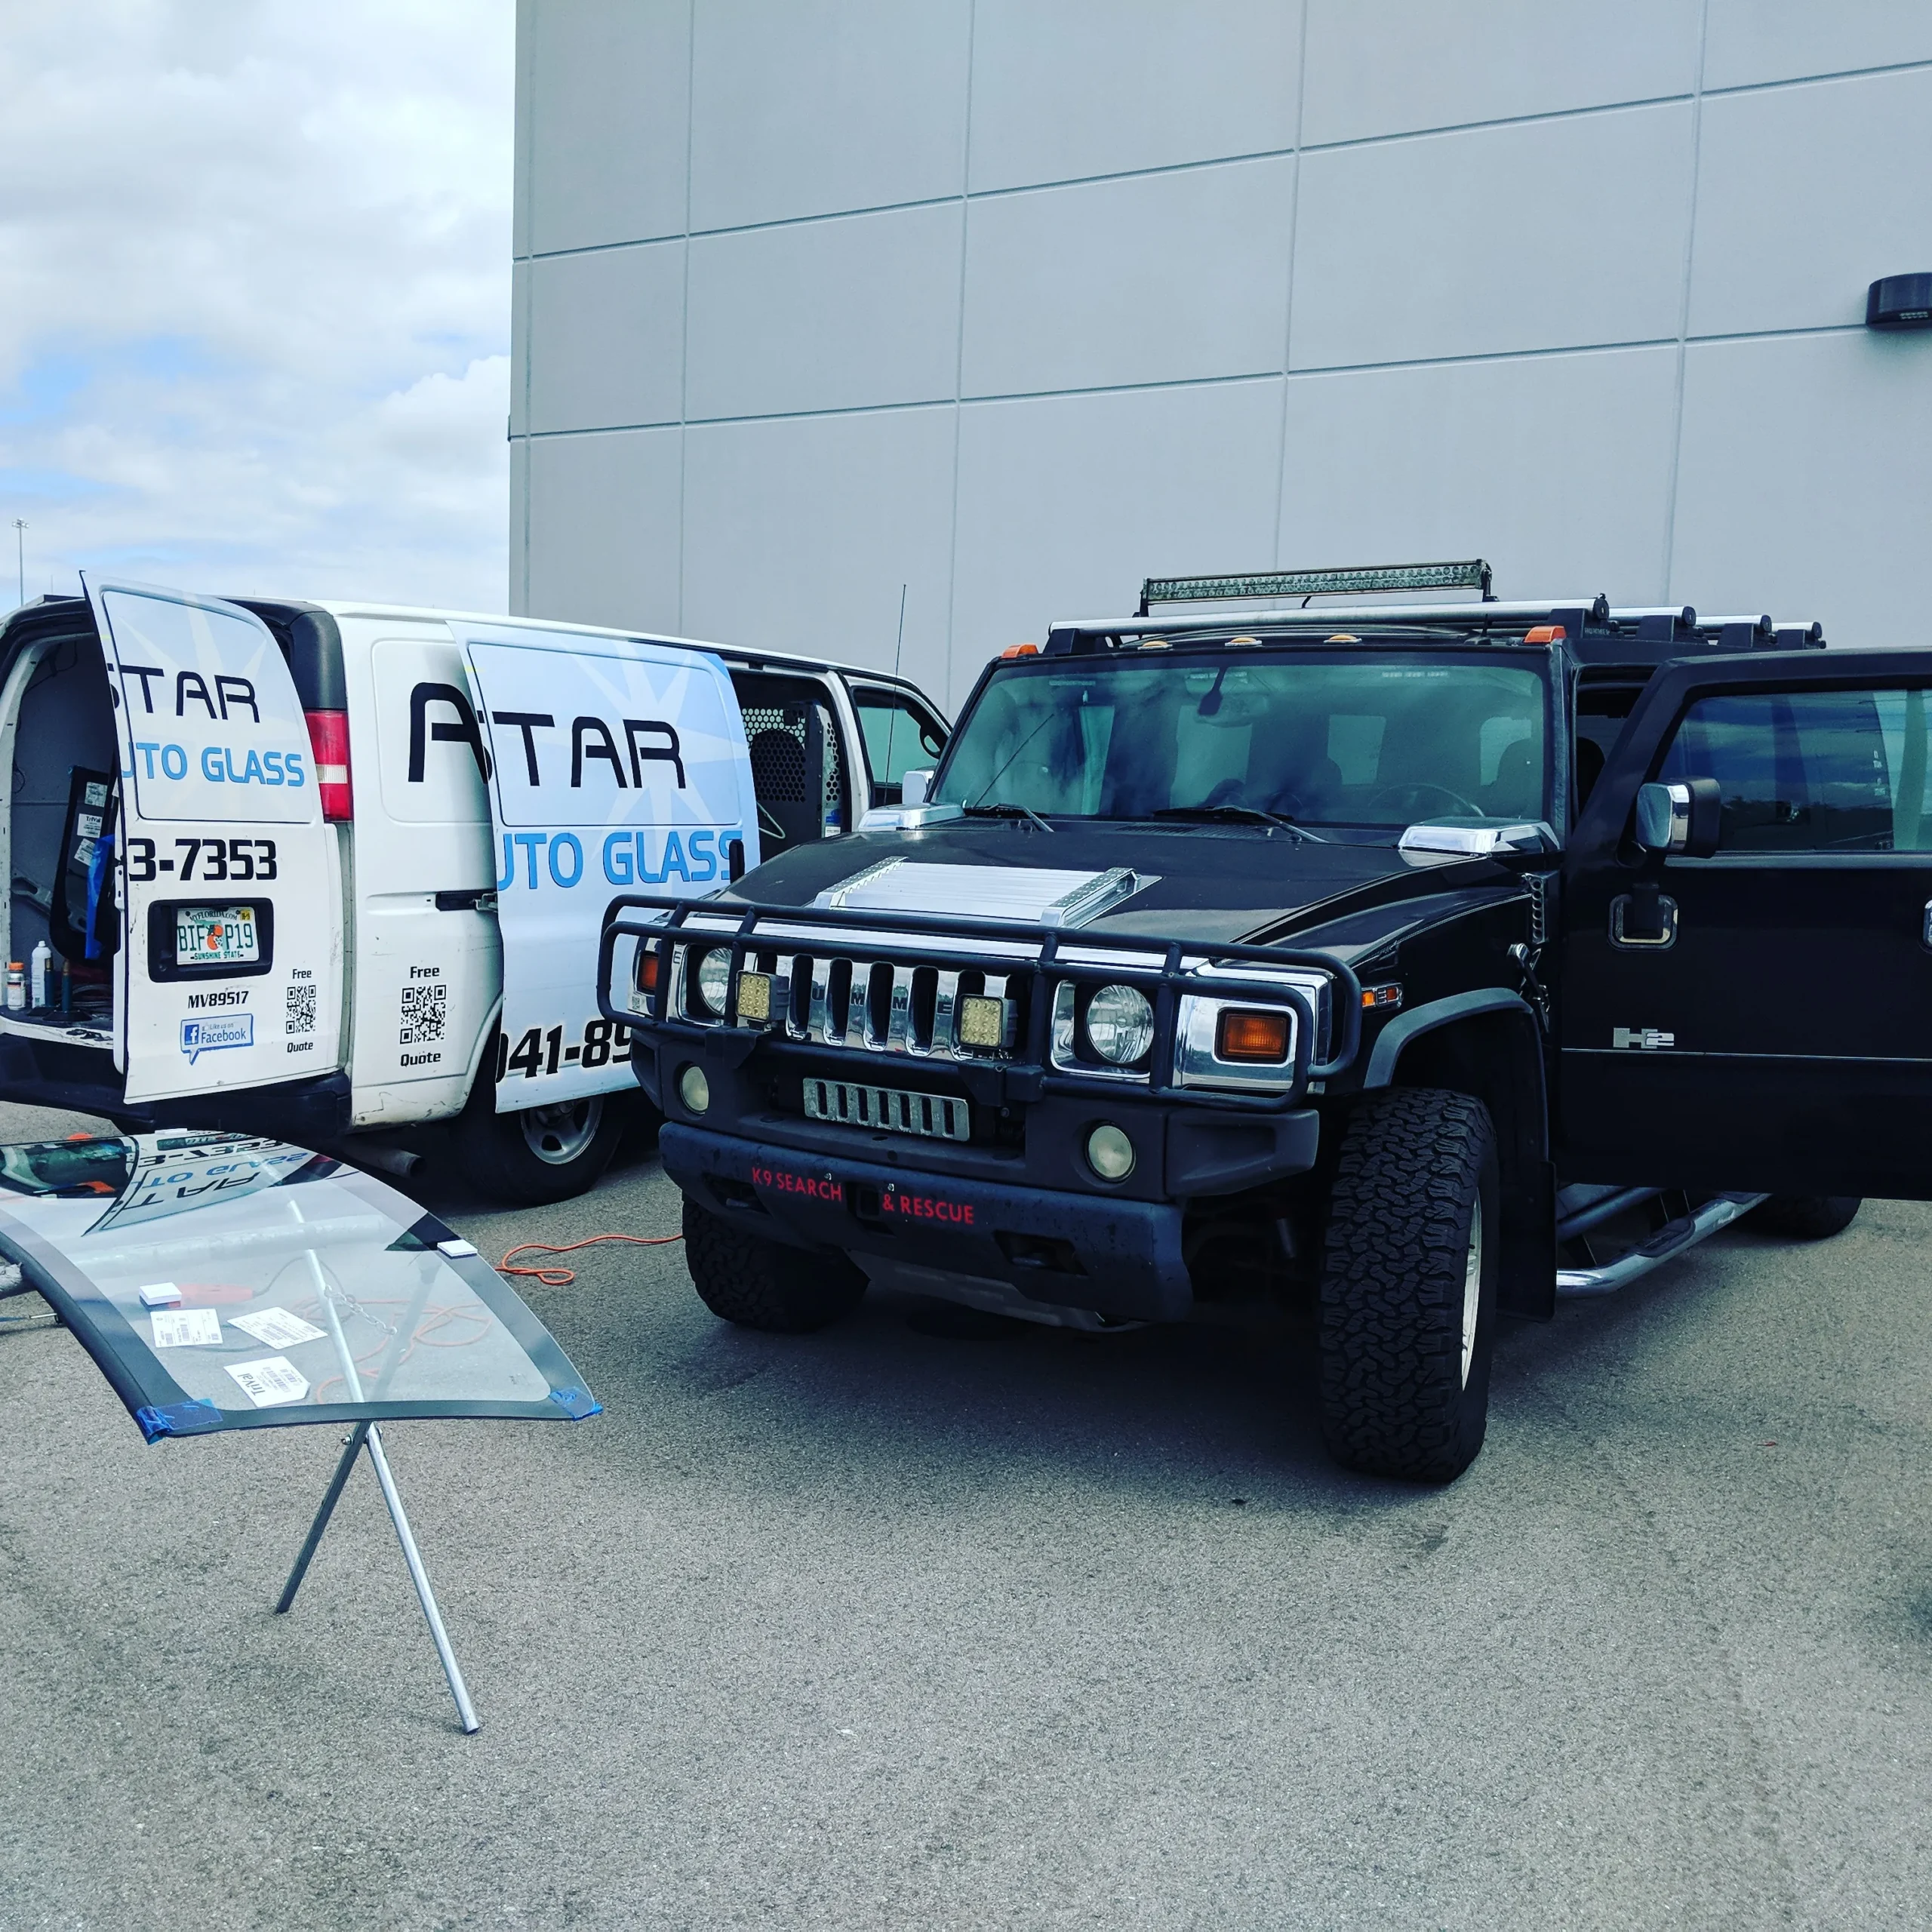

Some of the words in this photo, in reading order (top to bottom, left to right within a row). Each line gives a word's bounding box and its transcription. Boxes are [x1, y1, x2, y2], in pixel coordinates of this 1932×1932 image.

[201, 746, 305, 787] GLASS
[127, 838, 278, 881] 3-7353
[194, 952, 221, 960] SUNSHINE
[223, 950, 241, 958] STATE
[293, 968, 312, 979] Free
[410, 966, 440, 978] Free
[187, 991, 249, 1008] MV89517
[202, 1027, 247, 1044] Facebook
[1613, 1027, 1674, 1049] H2
[287, 1041, 313, 1054] Quote
[400, 1052, 441, 1067] Quote
[752, 1167, 772, 1186] K9
[777, 1172, 842, 1202] SEARCH
[882, 1194, 895, 1212] &
[900, 1195, 974, 1224] RESCUE
